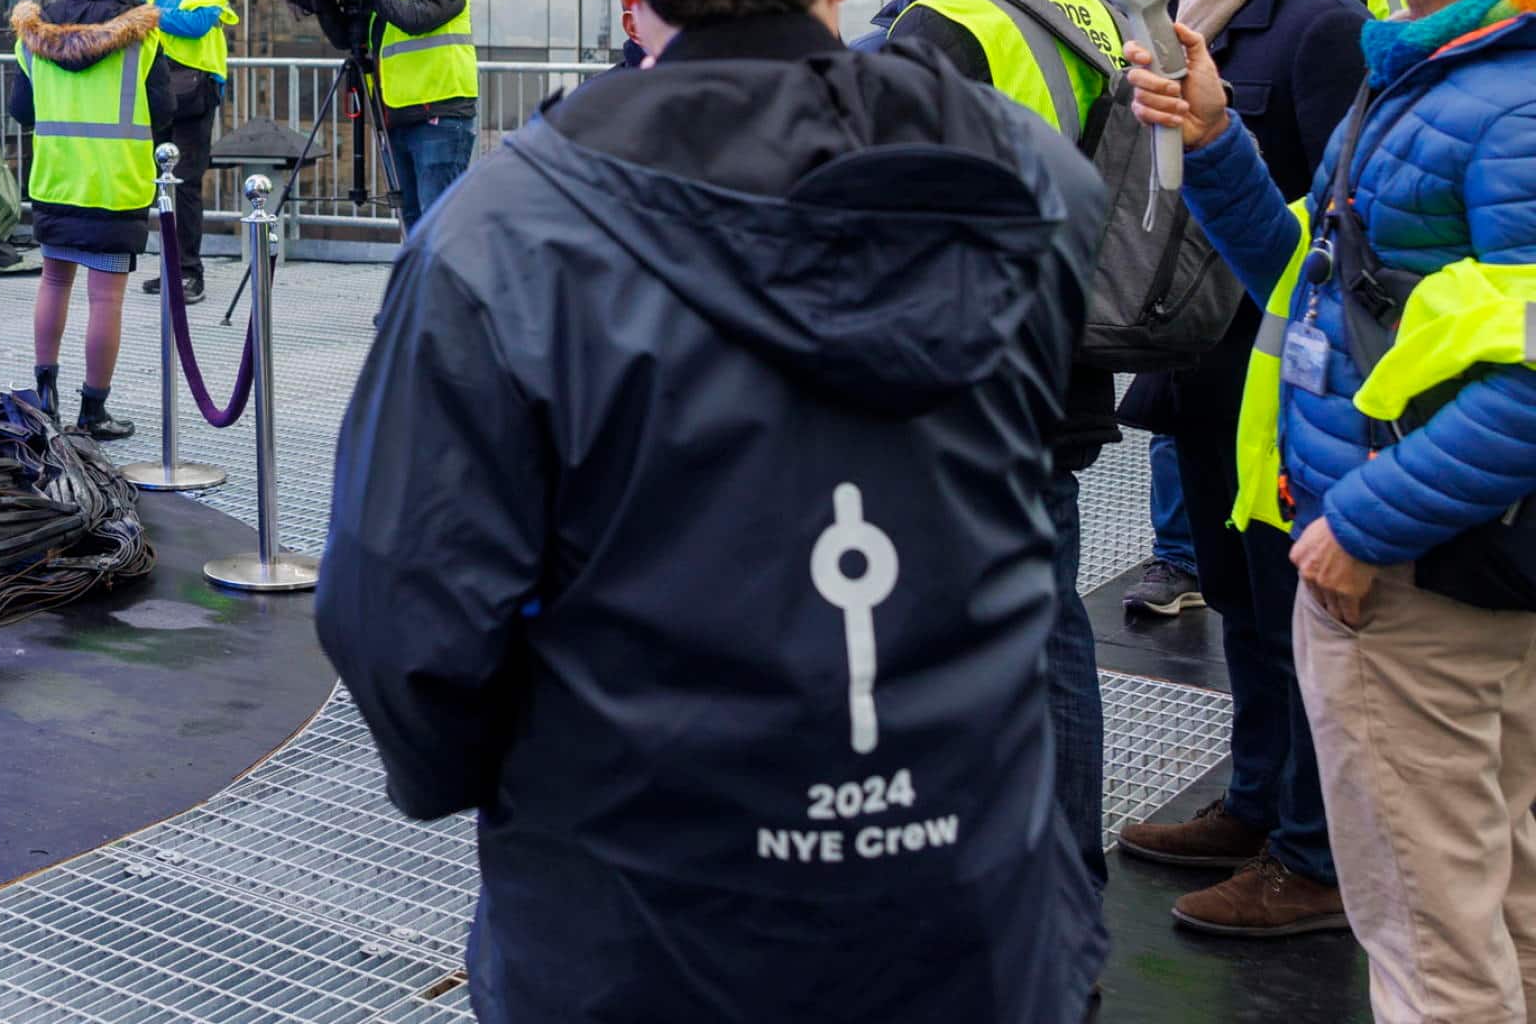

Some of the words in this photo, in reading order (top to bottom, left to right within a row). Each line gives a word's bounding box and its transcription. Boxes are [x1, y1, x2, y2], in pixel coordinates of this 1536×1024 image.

[807, 768, 917, 820] 2024
[757, 827, 845, 863] NYE
[855, 813, 959, 859] Crew
